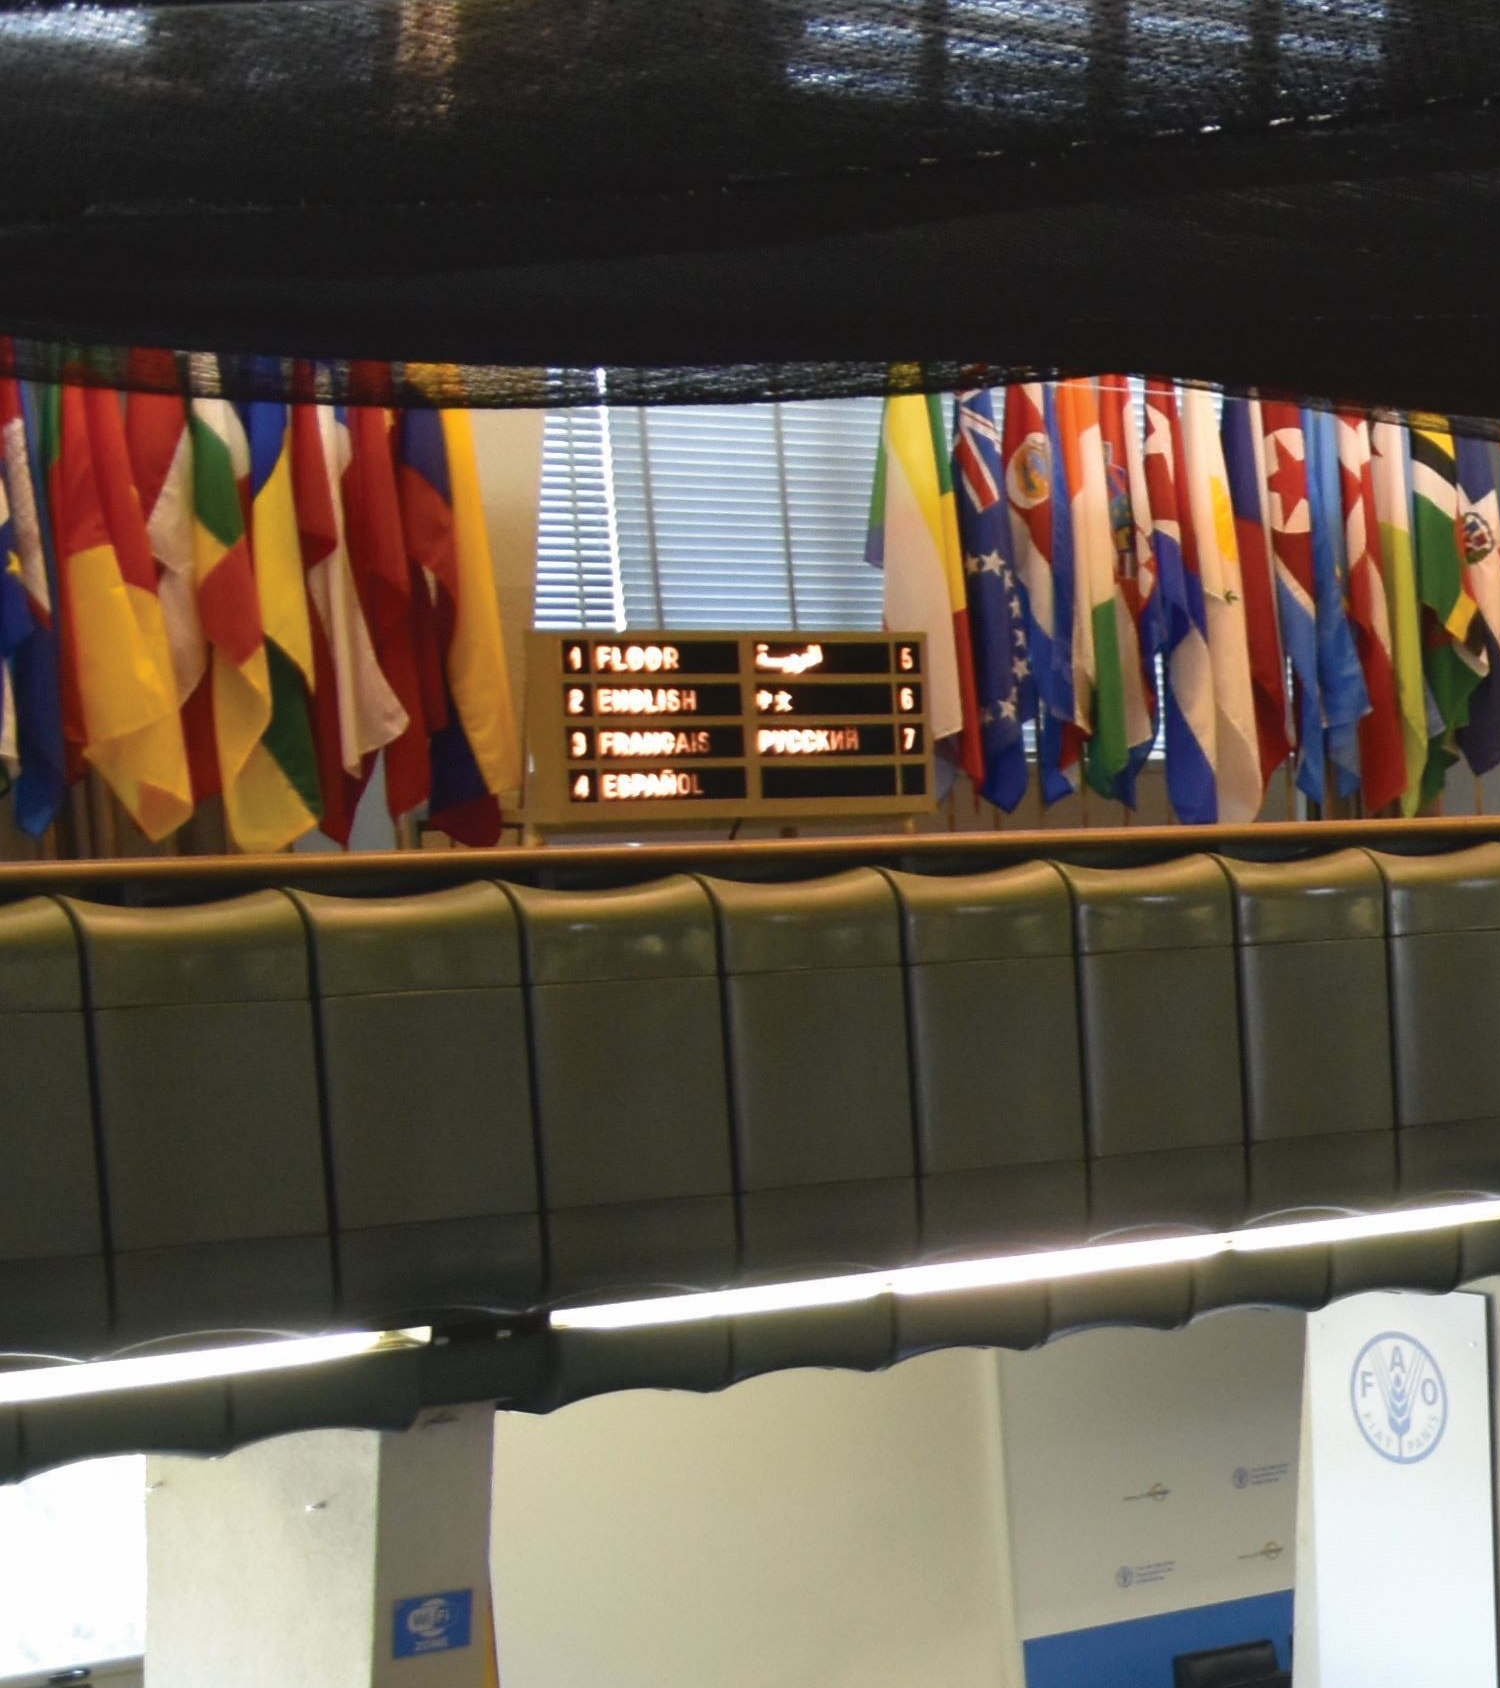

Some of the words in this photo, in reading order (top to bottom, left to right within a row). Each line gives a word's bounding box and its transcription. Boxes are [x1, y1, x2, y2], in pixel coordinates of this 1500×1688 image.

[569, 646, 582, 670] 1
[596, 645, 679, 672] FLOOR
[901, 647, 914, 670] 5
[569, 688, 584, 714] 2
[597, 688, 697, 714] ENGLISH
[900, 687, 914, 711] 6
[572, 731, 587, 757] 3
[598, 731, 710, 756] FRANÇAIS
[757, 727, 860, 754] РУССКИЙ
[904, 727, 916, 750] 7
[574, 774, 590, 798] 4
[601, 769, 704, 799] ESPAÑOL
[1360, 1345, 1438, 1406] FAO
